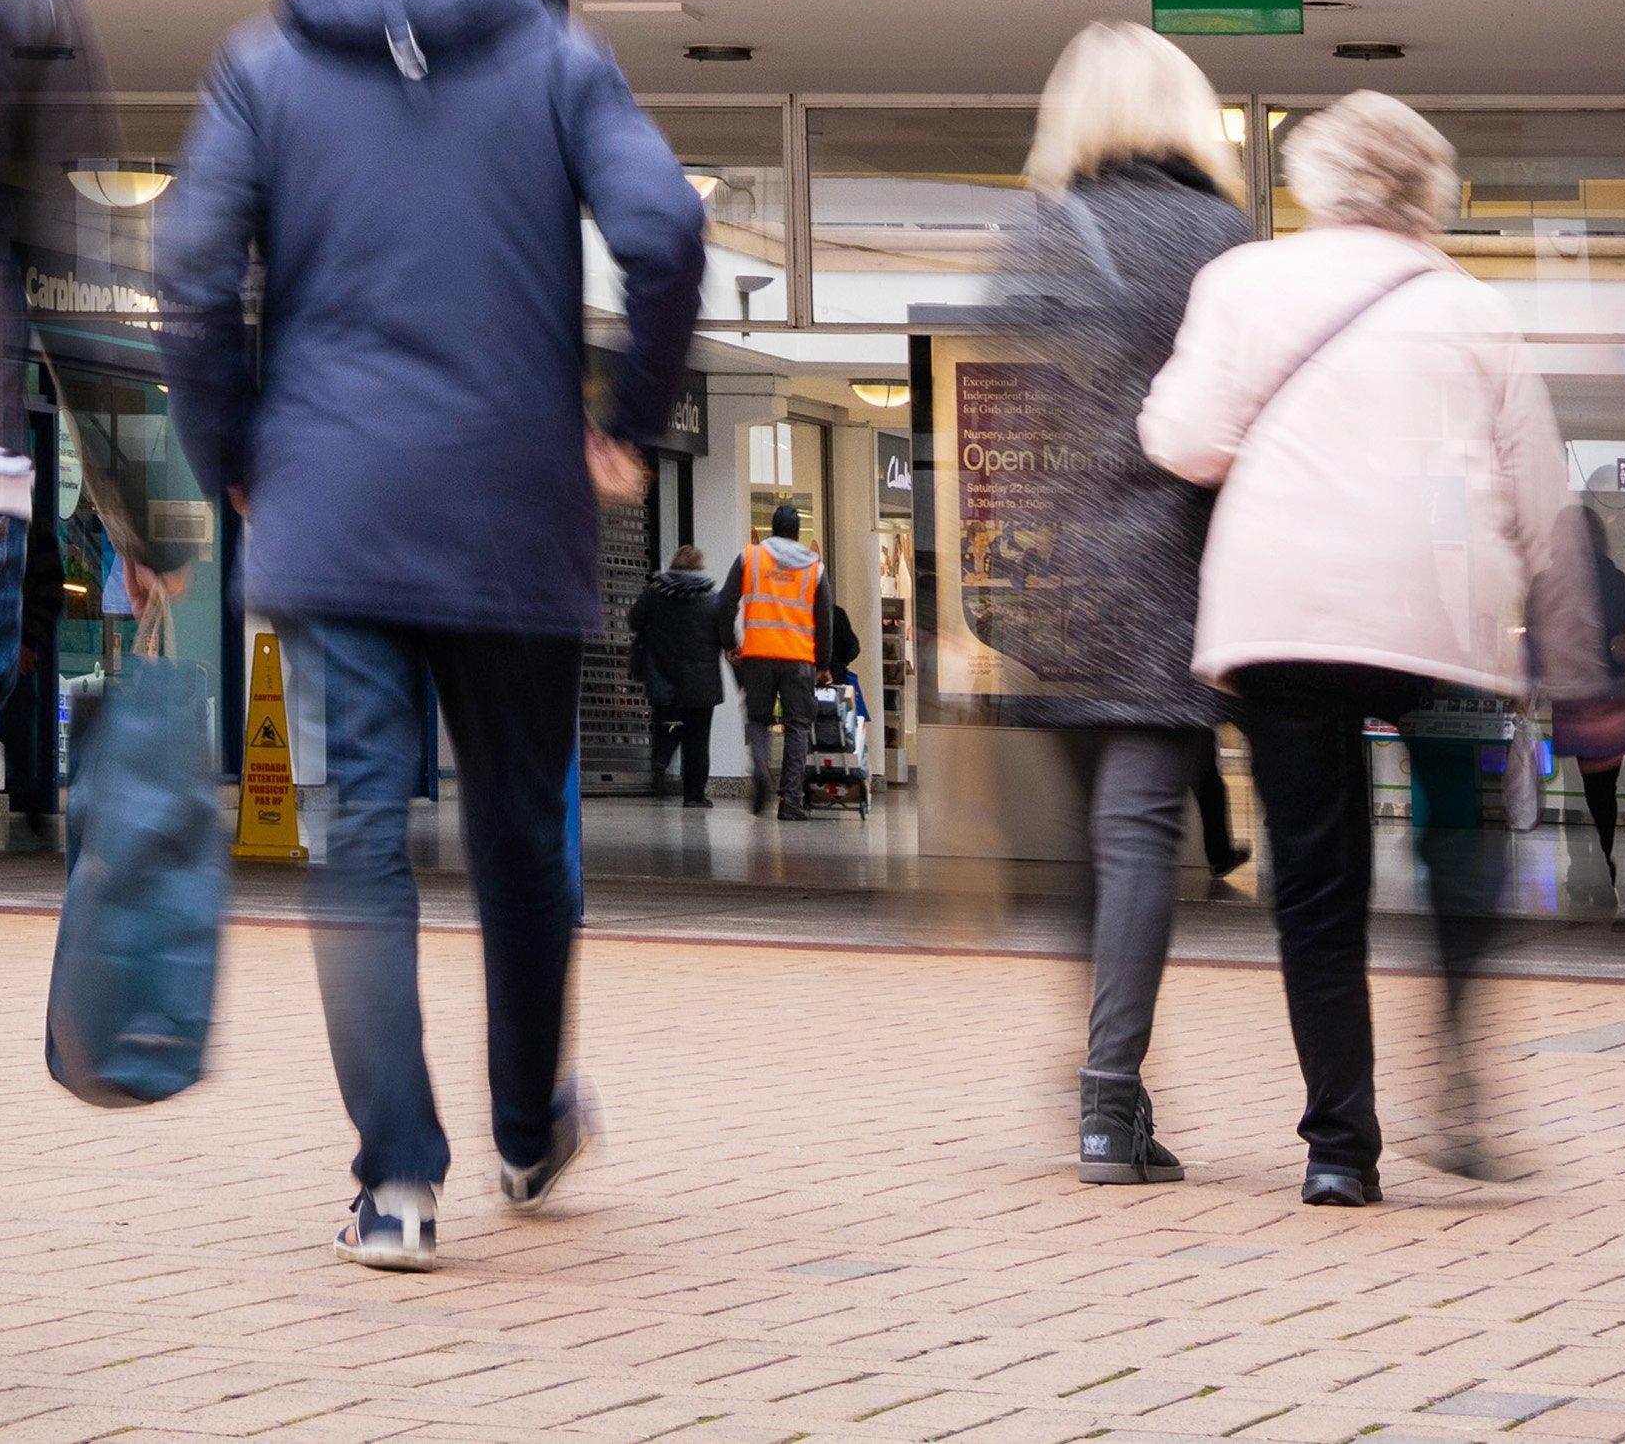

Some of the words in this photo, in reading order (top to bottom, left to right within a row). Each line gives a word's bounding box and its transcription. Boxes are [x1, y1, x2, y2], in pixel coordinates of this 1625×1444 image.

[26, 265, 112, 312] Carphone
[963, 376, 1018, 389] Exceptional
[963, 390, 1022, 403] Independent
[963, 443, 1036, 476] Open
[1009, 484, 1023, 494] 22
[250, 762, 287, 773] CUIDADO
[247, 773, 290, 784] ATTENTION
[248, 784, 290, 795] VORSICHT
[254, 795, 272, 806] PAS
